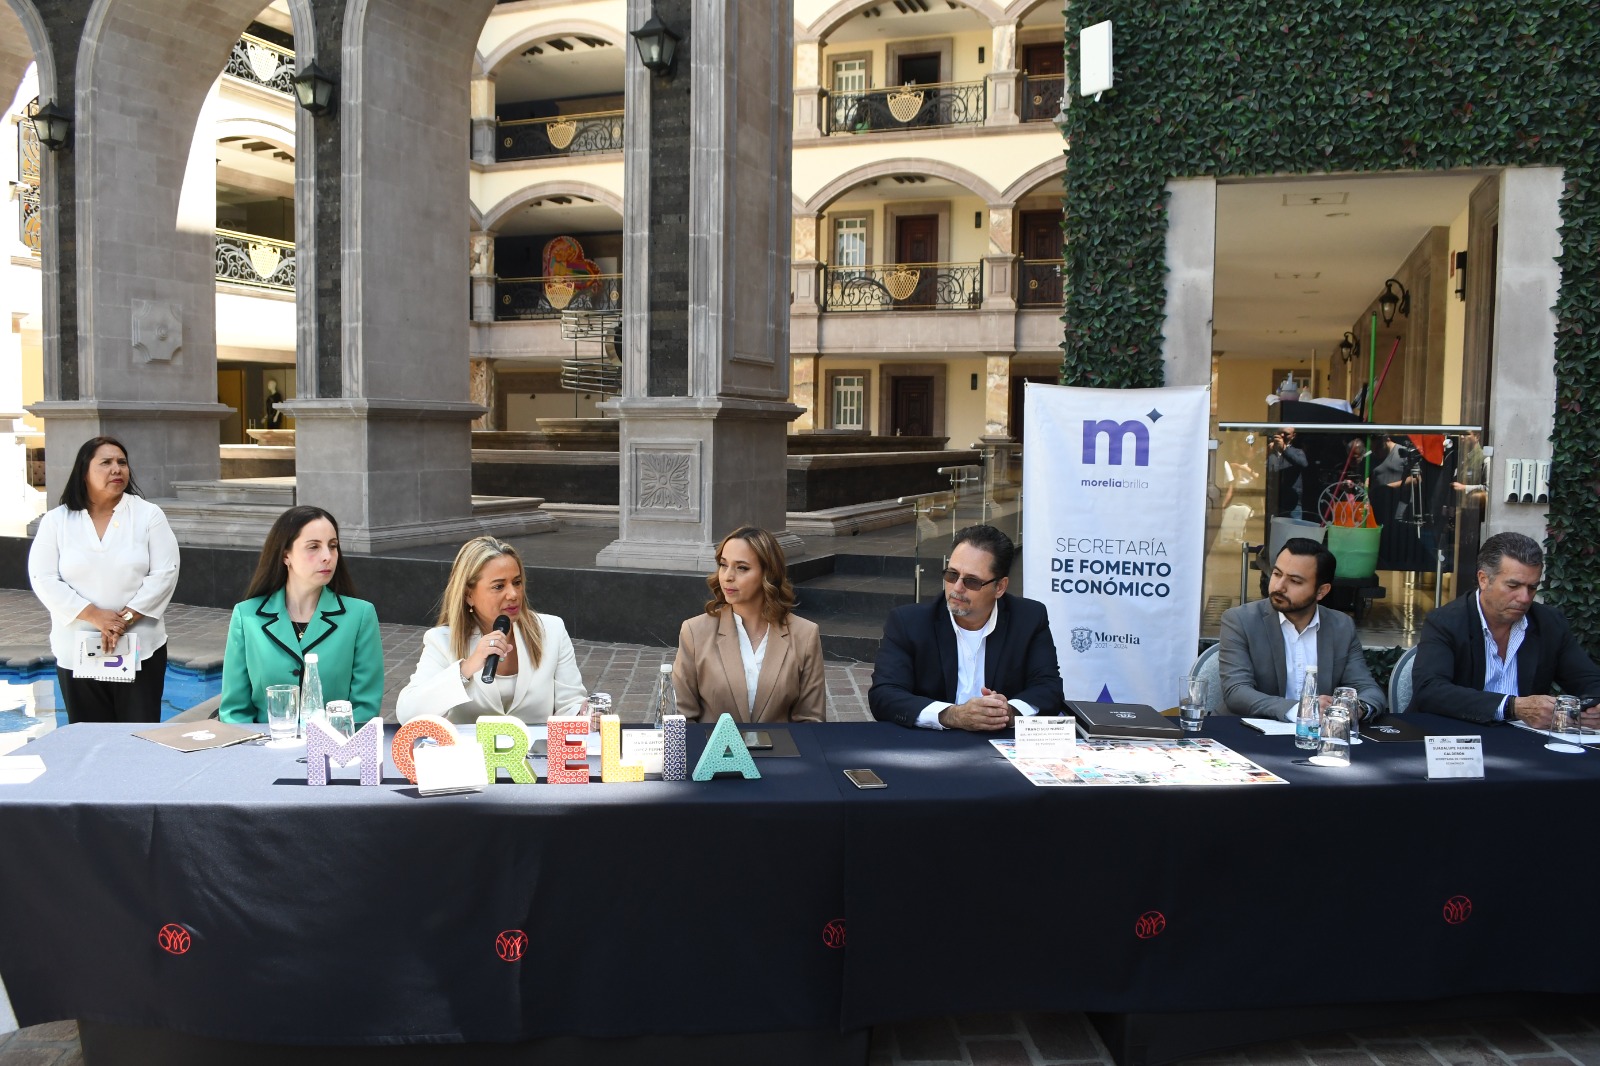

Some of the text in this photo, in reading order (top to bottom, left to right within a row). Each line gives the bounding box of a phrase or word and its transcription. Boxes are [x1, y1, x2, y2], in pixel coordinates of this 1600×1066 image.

[1082, 419, 1150, 466] m
[1081, 478, 1149, 489] moreliabrilla
[1056, 537, 1168, 556] SECRETARÍA
[1051, 558, 1172, 577] DE FOMENTO
[1051, 577, 1171, 598] ECONÓMICO
[1095, 631, 1140, 645] Morelia
